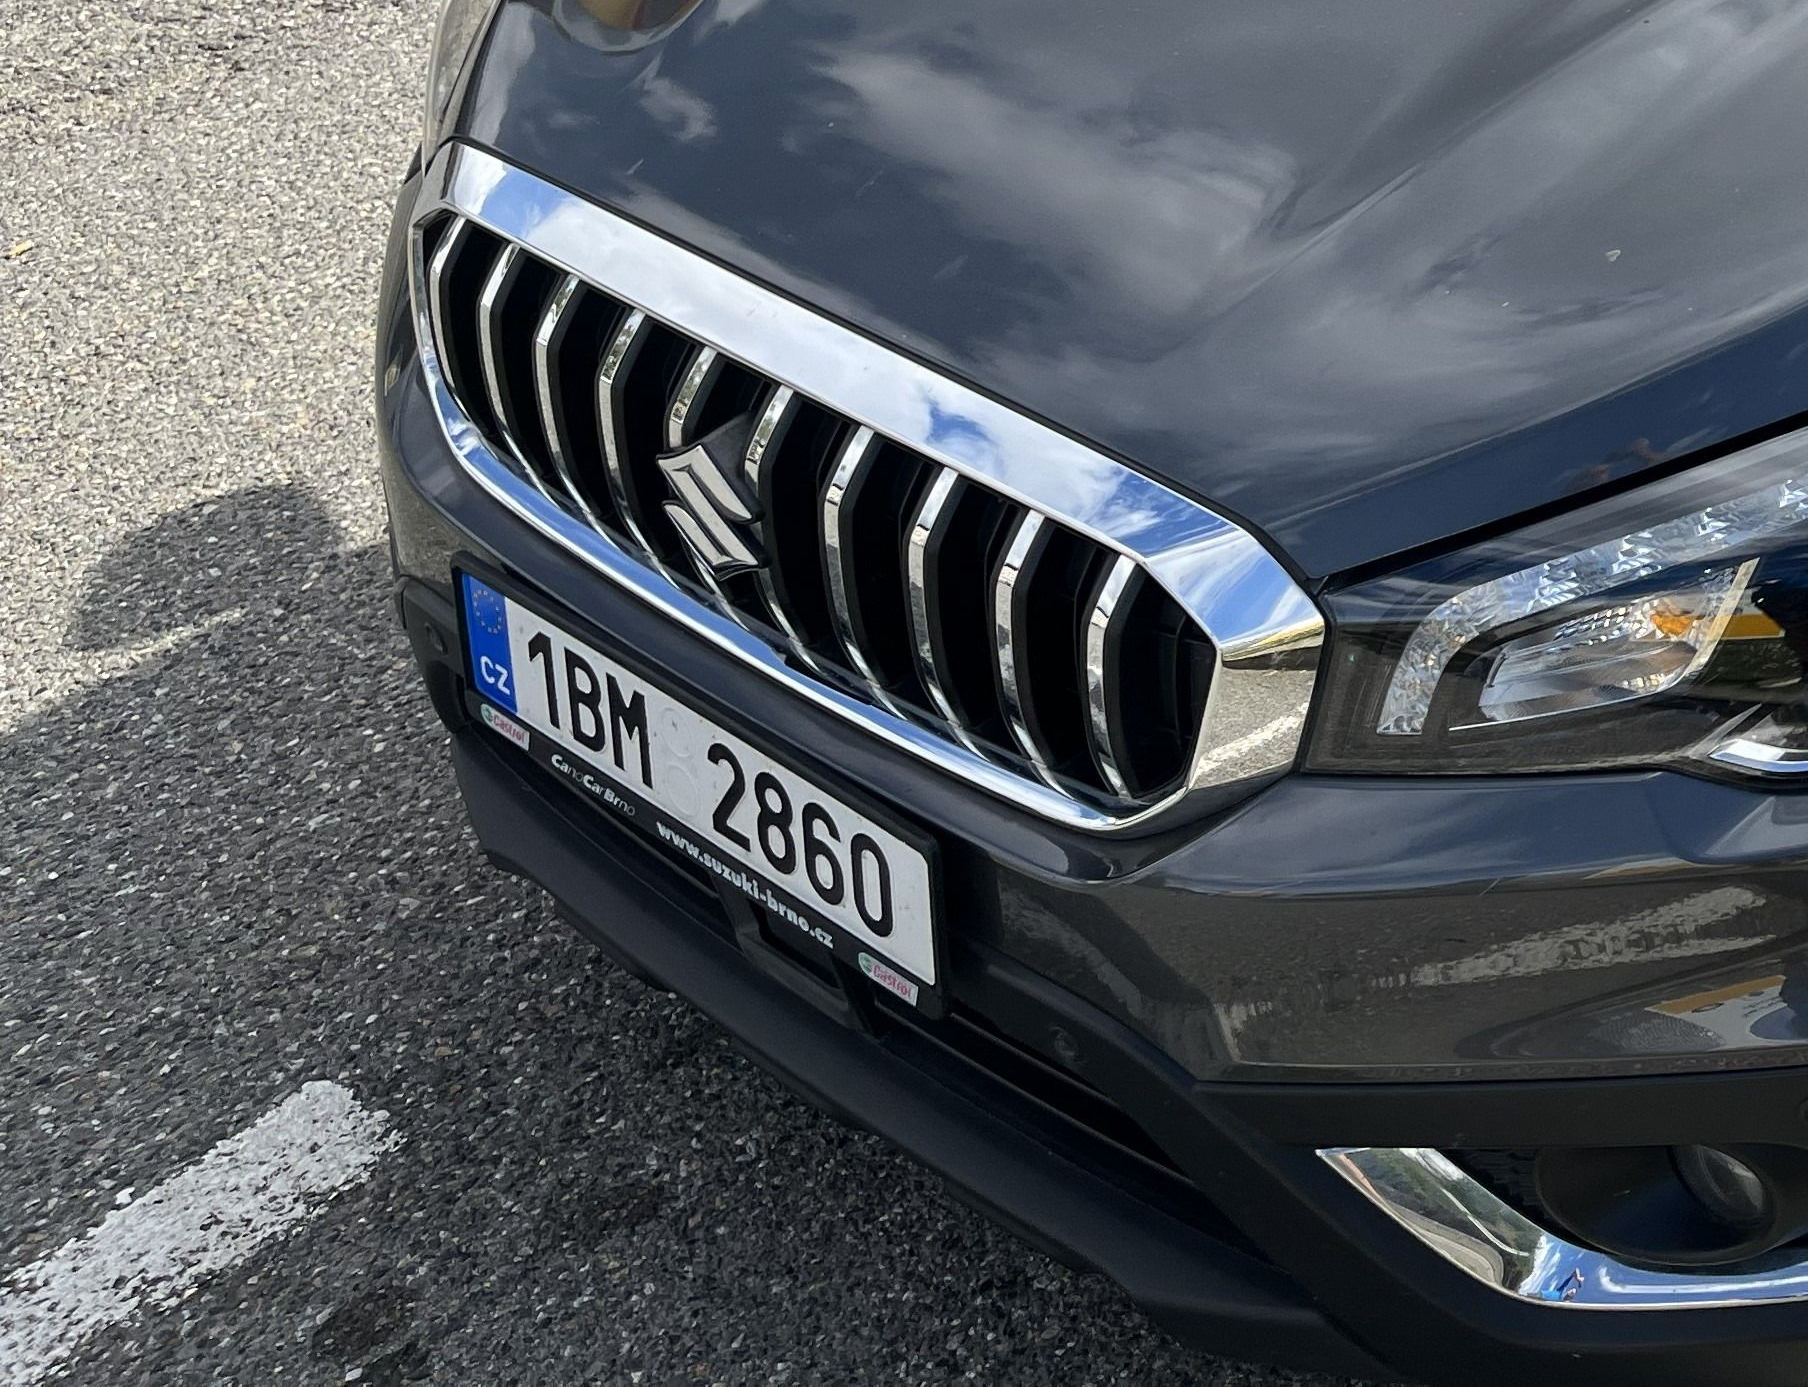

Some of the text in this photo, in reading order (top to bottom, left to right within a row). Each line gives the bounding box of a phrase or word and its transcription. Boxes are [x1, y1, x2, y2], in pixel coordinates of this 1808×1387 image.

[480, 654, 511, 696] CZ
[493, 714, 526, 743] Castrol
[528, 630, 895, 939] 1BM 2860
[656, 821, 834, 949] www.suzuki-brno.cz
[873, 964, 913, 1000] Castrol
